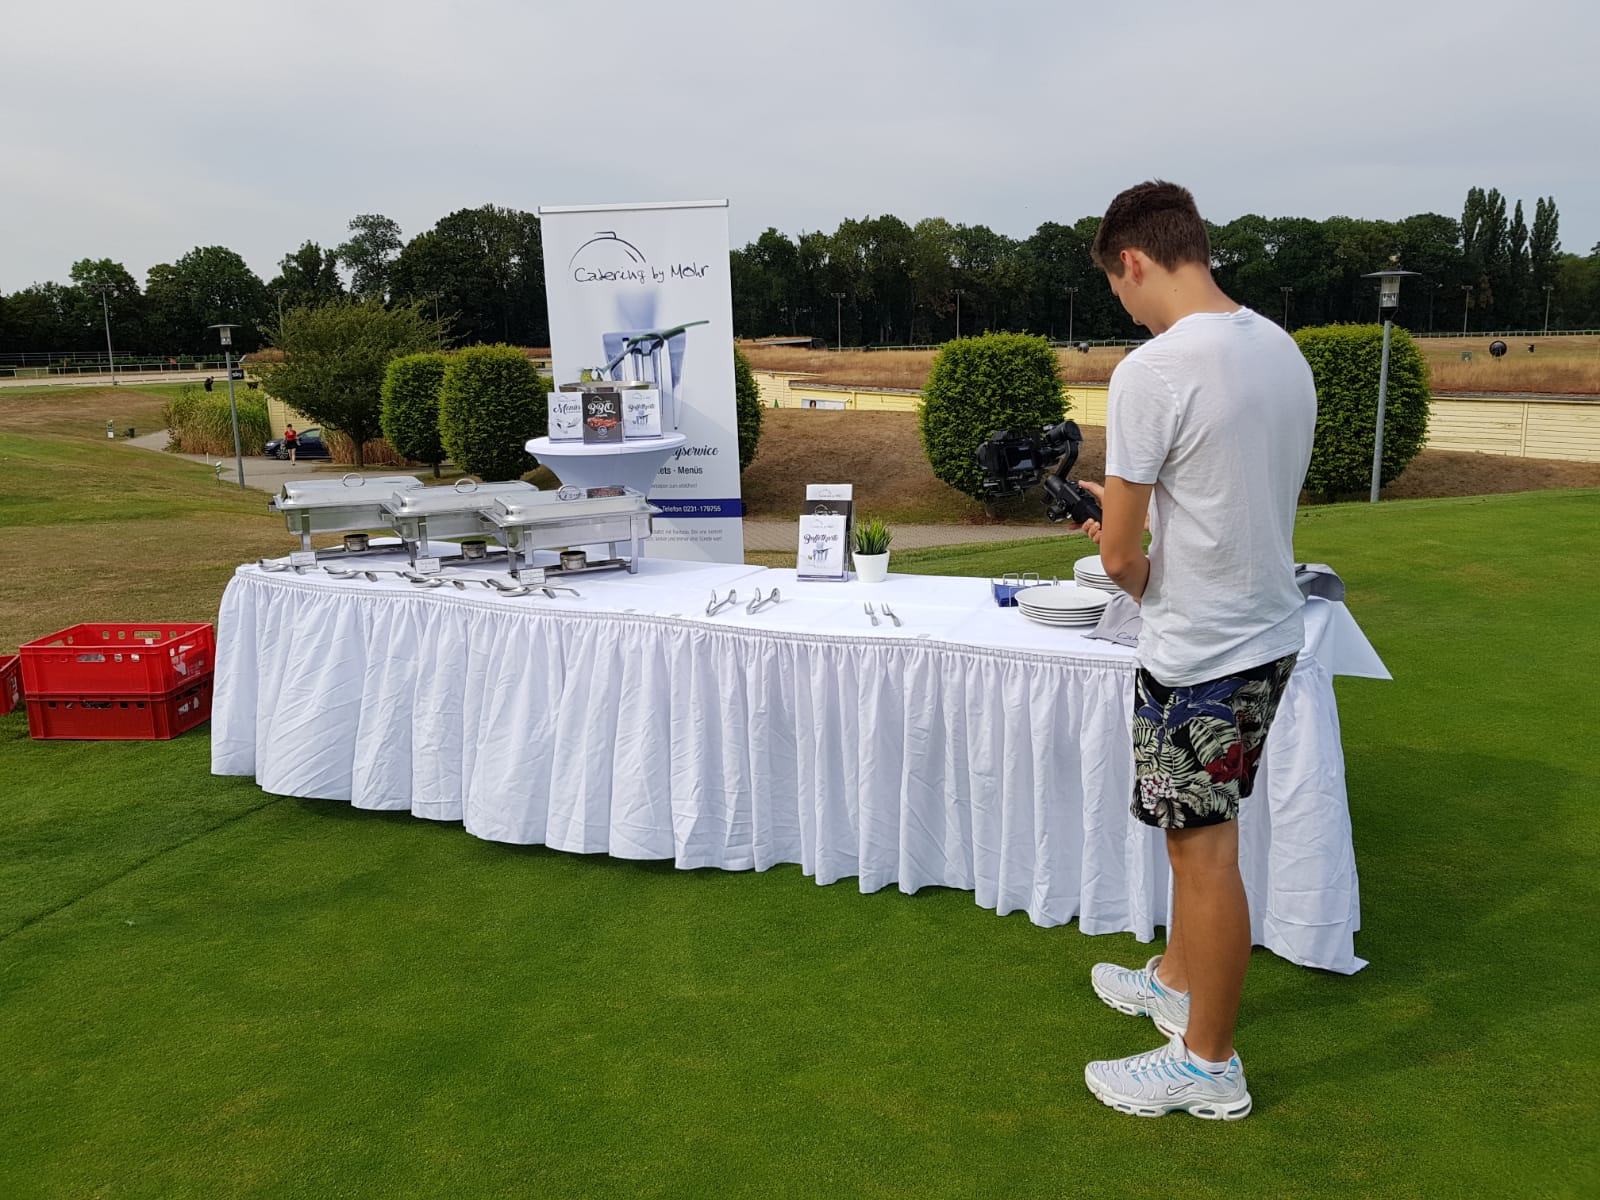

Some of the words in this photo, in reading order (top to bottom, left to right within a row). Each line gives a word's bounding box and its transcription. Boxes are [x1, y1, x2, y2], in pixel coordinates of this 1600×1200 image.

[574, 266, 645, 284] Catering
[652, 265, 665, 283] by
[673, 444, 719, 460] gservice
[658, 466, 672, 475] ets
[677, 465, 703, 475] Menüs
[662, 505, 683, 513] Telefon
